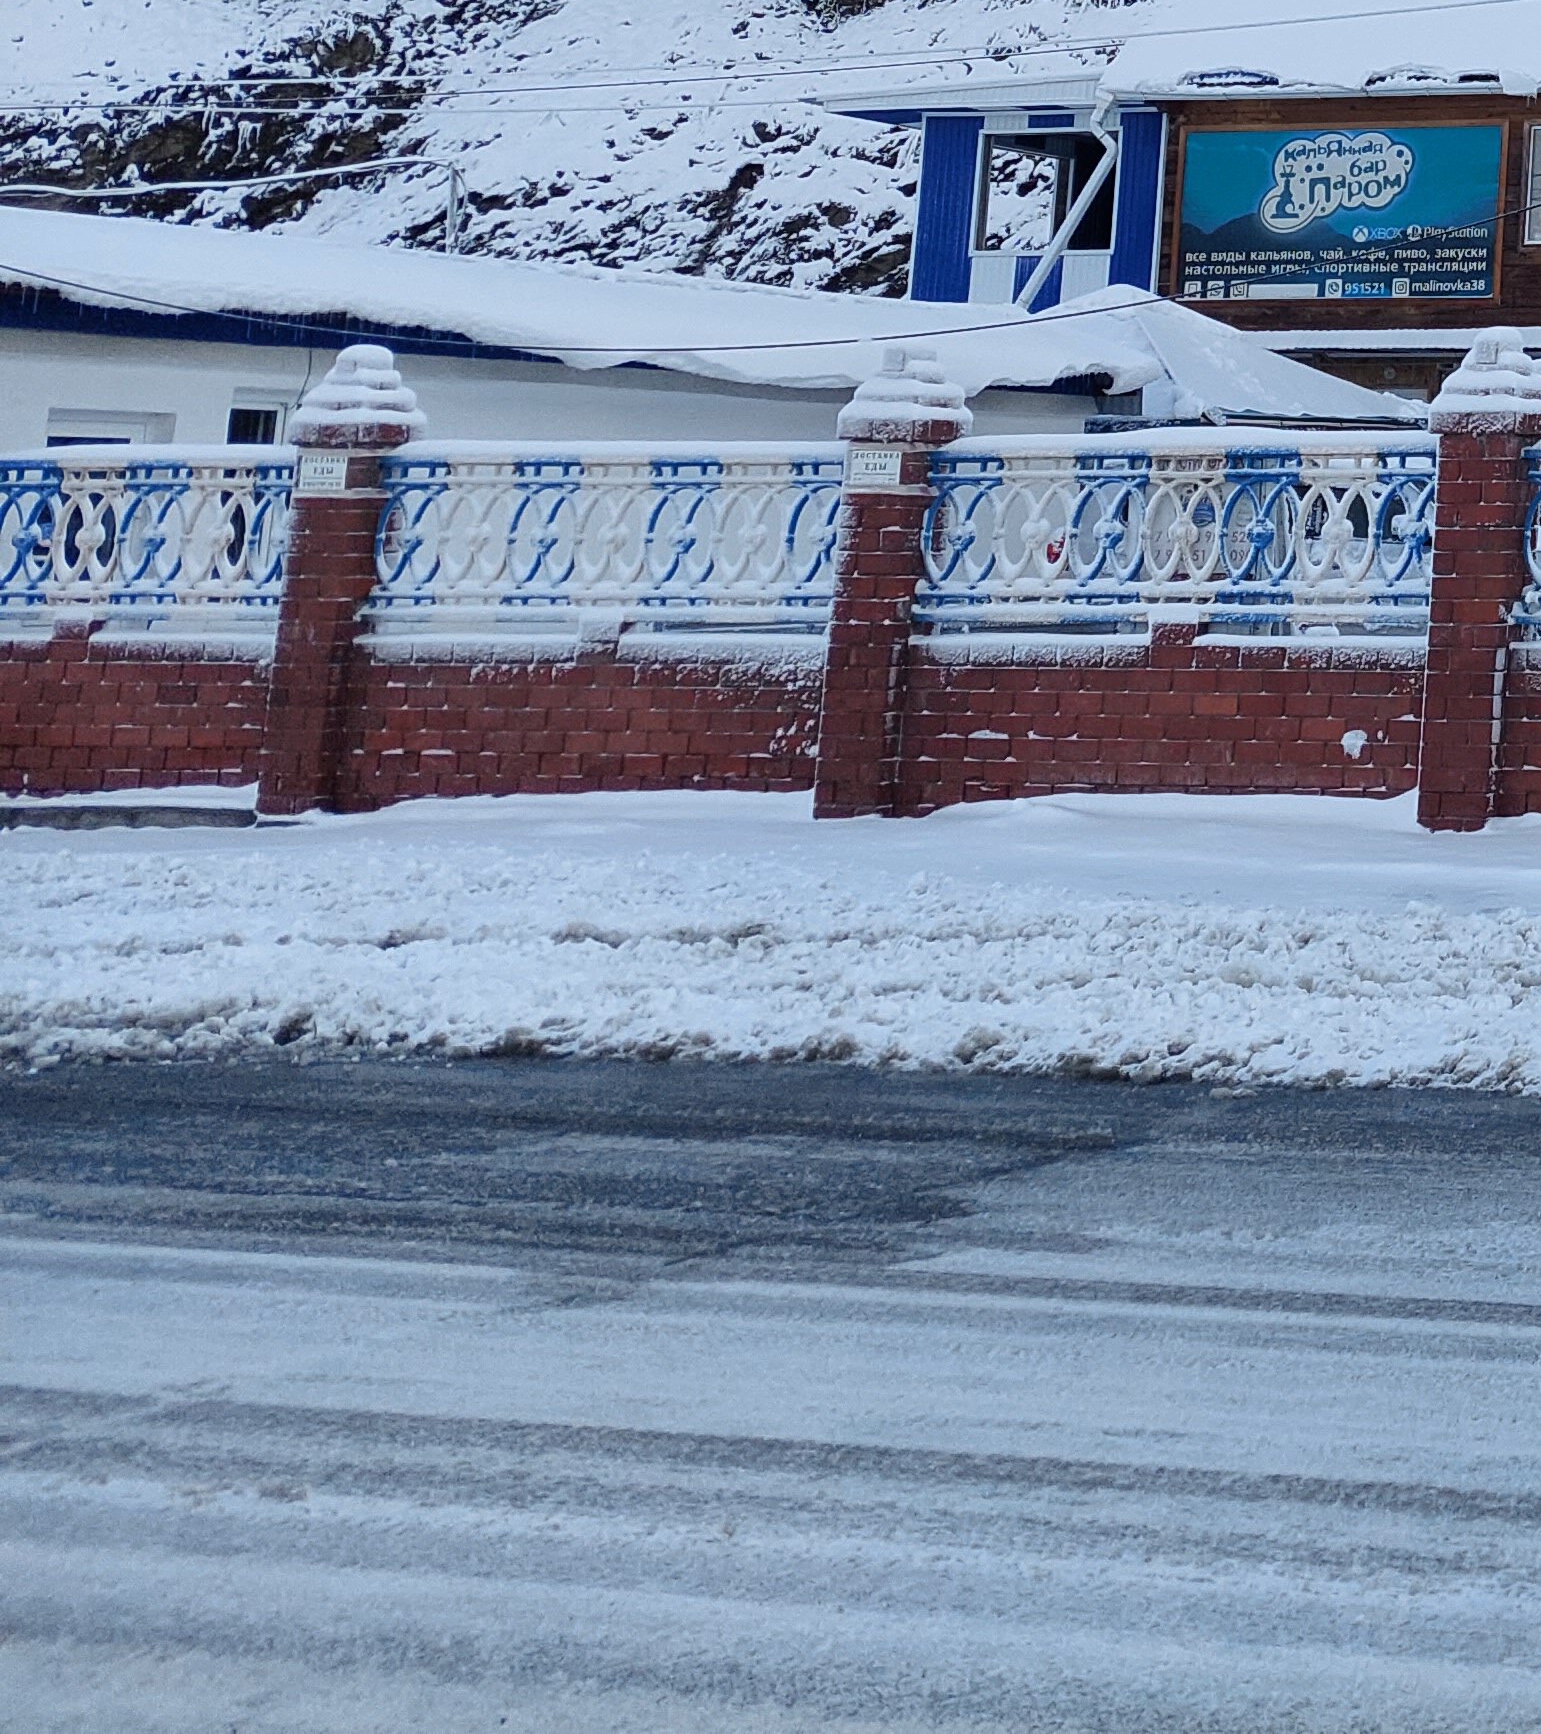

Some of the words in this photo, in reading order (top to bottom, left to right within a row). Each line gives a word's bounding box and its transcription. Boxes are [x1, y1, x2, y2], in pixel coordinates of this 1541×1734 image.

[1349, 157, 1387, 177] бар
[1308, 173, 1402, 205] Паром
[1370, 228, 1403, 240] XBOX
[1423, 226, 1488, 242] PlayStation
[1186, 252, 1207, 262] все
[1211, 251, 1246, 263] виды
[1250, 250, 1315, 262] кальянов,
[1394, 248, 1431, 261] пиво,
[1434, 247, 1487, 262] закуски
[1185, 263, 1266, 276] настольные
[1314, 262, 1399, 276] спортивные
[1402, 261, 1487, 275] трансляции
[1344, 282, 1385, 295] 951521
[1412, 279, 1485, 293] malinovka38
